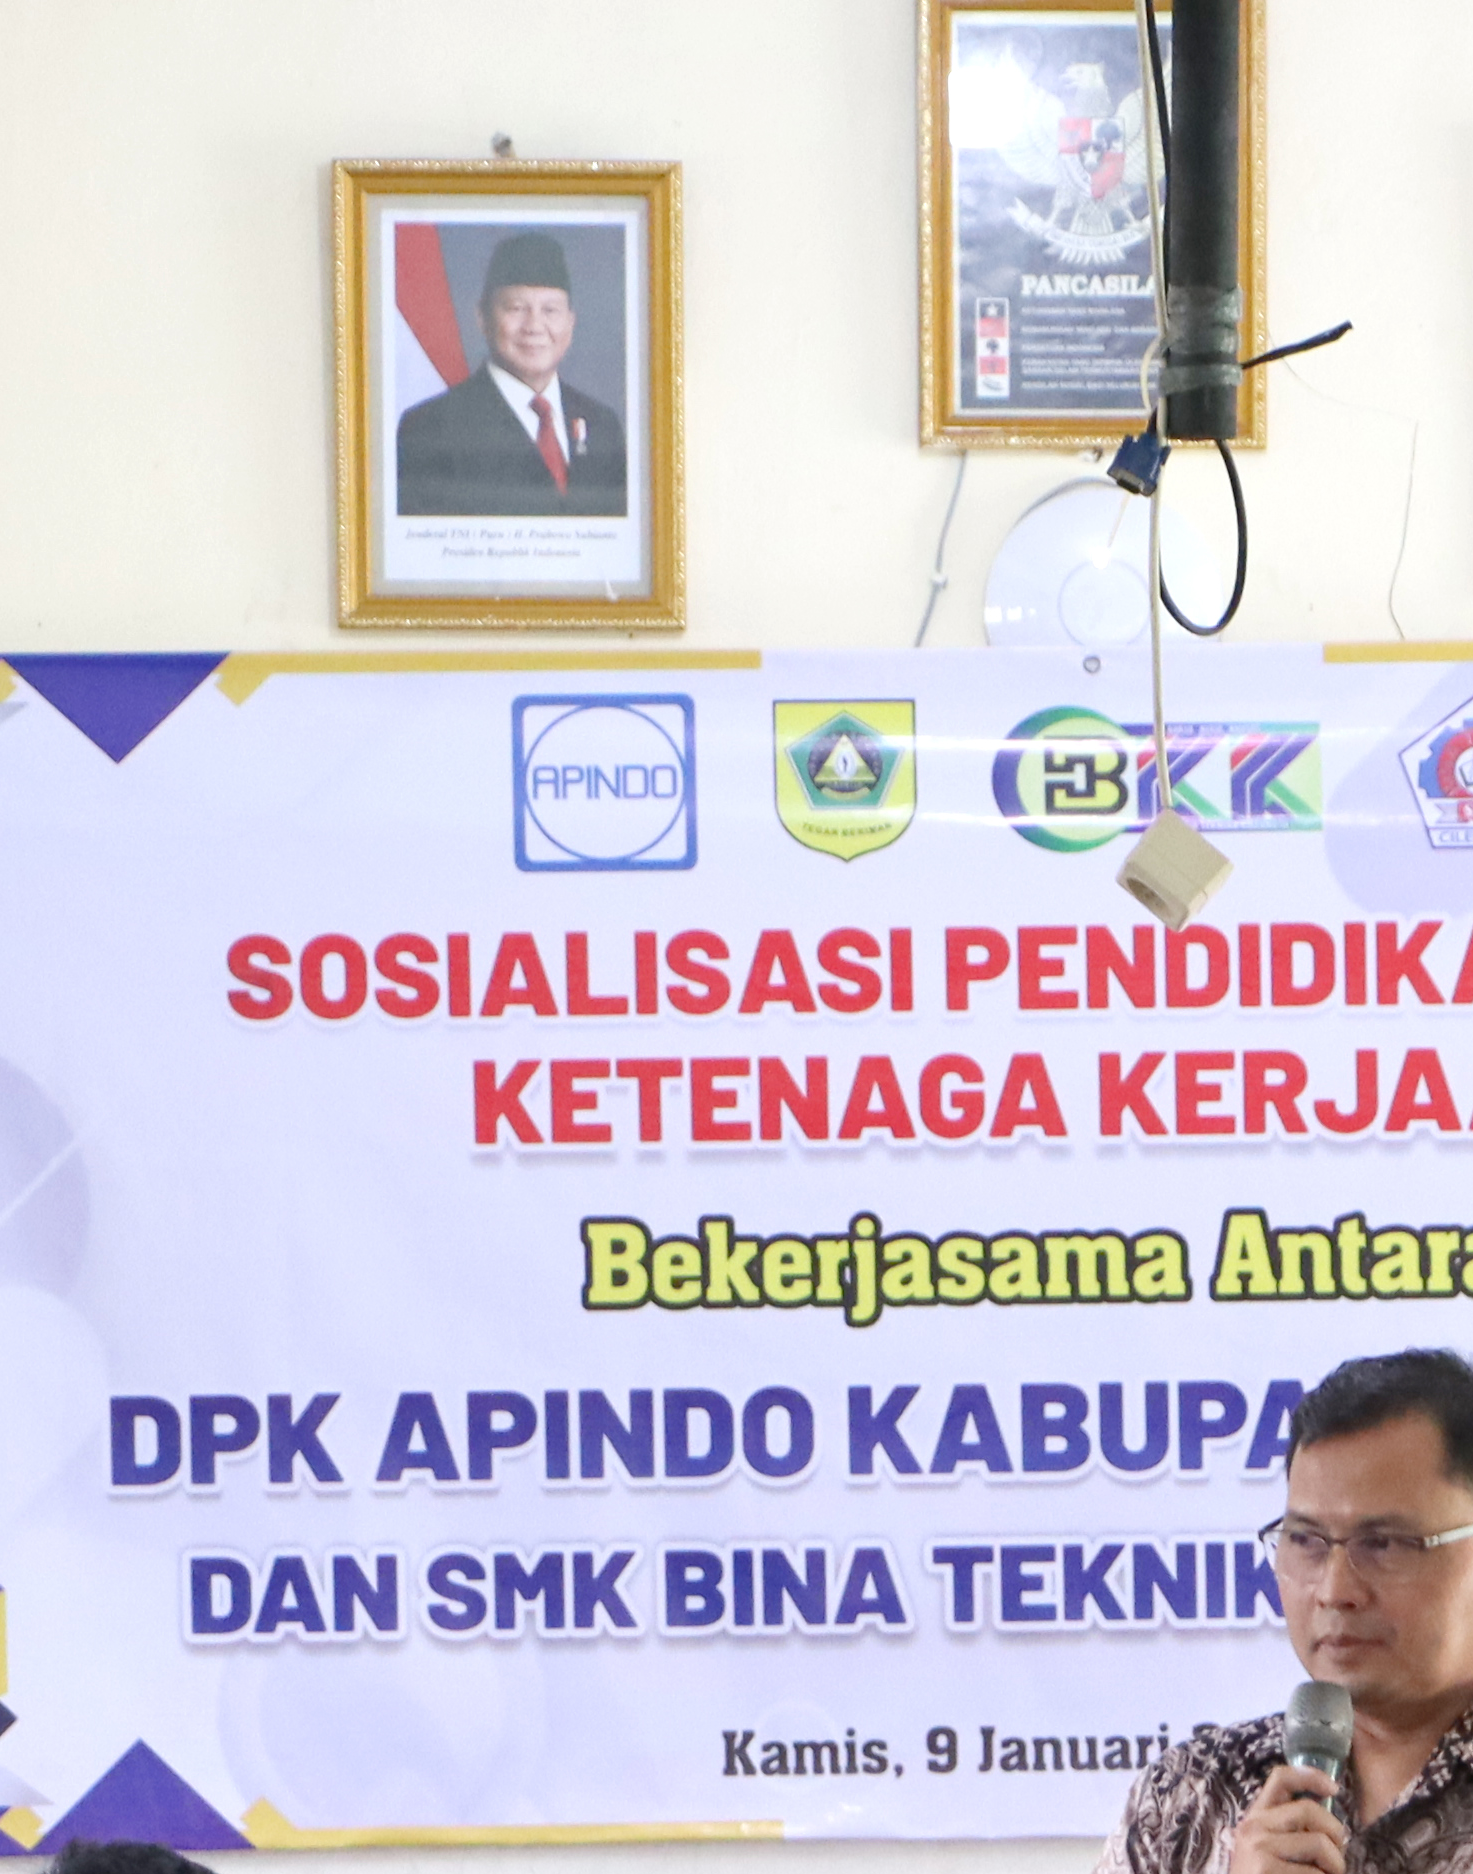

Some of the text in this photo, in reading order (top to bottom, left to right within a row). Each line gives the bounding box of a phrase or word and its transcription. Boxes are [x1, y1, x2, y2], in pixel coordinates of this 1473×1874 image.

[532, 764, 678, 800] APINDO
[226, 927, 914, 1020] SOSIALISASI
[473, 1053, 1068, 1145] KETENAGA
[580, 1211, 1193, 1328] Bekerjasama
[109, 1392, 343, 1486] DPK
[376, 1386, 815, 1482] APINDO
[190, 1553, 398, 1635] DAN
[427, 1550, 636, 1631] SMK
[664, 1546, 906, 1627] BINA
[931, 1541, 1285, 1623] TEKNIK
[722, 1730, 905, 1778] Kamis,
[927, 1727, 958, 1773] 9
